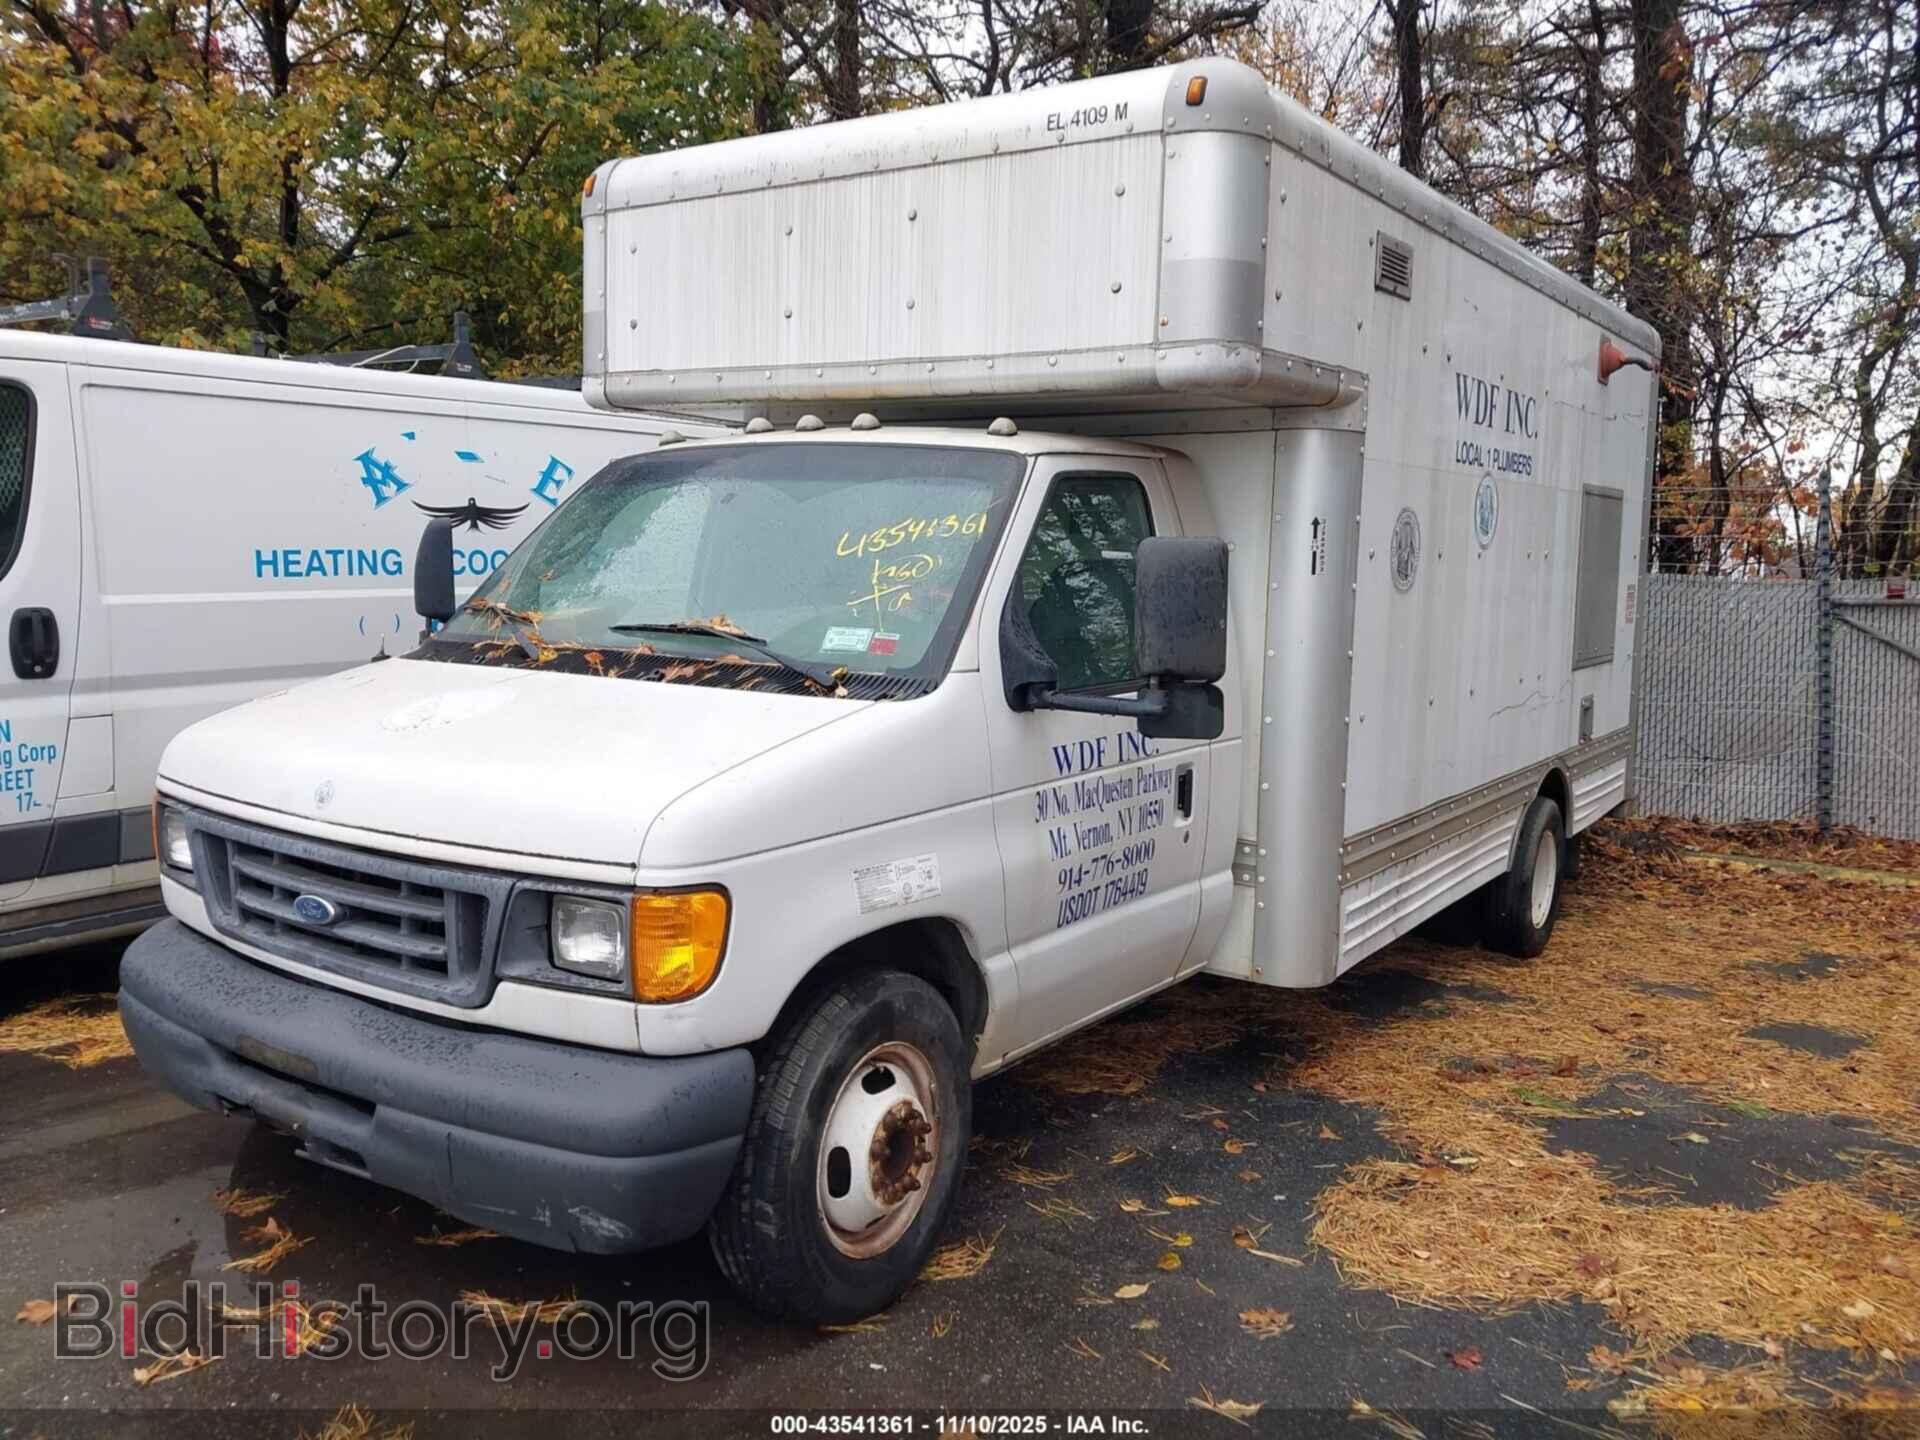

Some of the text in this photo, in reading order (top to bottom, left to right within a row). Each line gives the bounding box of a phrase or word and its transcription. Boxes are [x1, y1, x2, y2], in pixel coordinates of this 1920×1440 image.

[1070, 104, 1108, 127] 4109
[1114, 101, 1129, 121] M
[1456, 372, 1538, 440] WDF INC.
[1456, 440, 1484, 467] LOCAL
[1492, 448, 1533, 476] PLUMBERS
[254, 549, 403, 578] HEATING
[18, 743, 57, 765] Corp
[1052, 731, 1160, 775] WDF INC.
[1035, 764, 1174, 823] 30 No. MacQuesten Parkway
[1049, 798, 1164, 861] Mt. Vernon, NY 10550
[1058, 838, 1155, 896] 914-776-8000
[1057, 868, 1149, 928] USDOT 1764419
